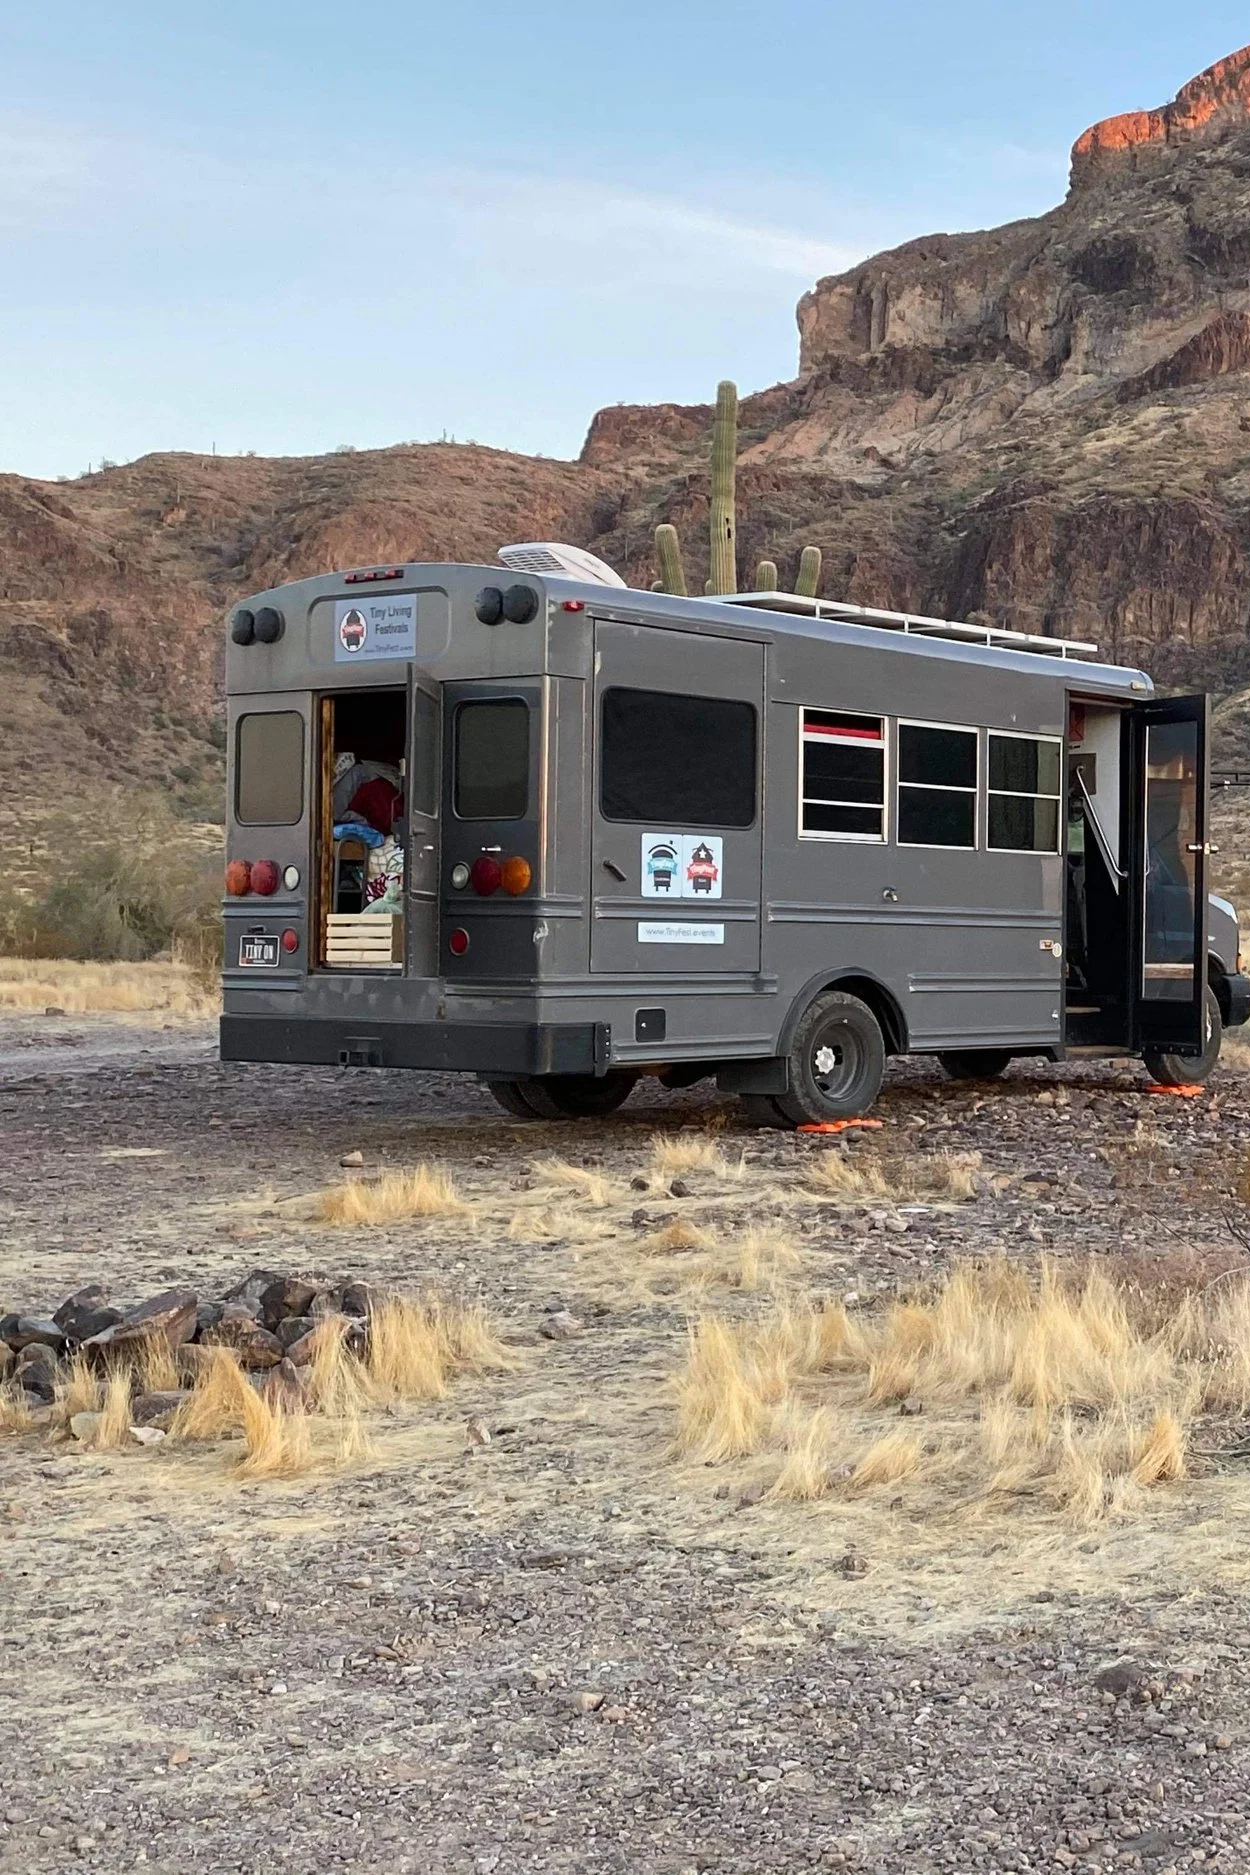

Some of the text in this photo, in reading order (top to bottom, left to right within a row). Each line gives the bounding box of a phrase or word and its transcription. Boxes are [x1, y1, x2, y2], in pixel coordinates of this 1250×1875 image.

[369, 604, 412, 620] Tiny Living
[375, 622, 409, 635] Festivals
[245, 944, 274, 960] TINY ON
